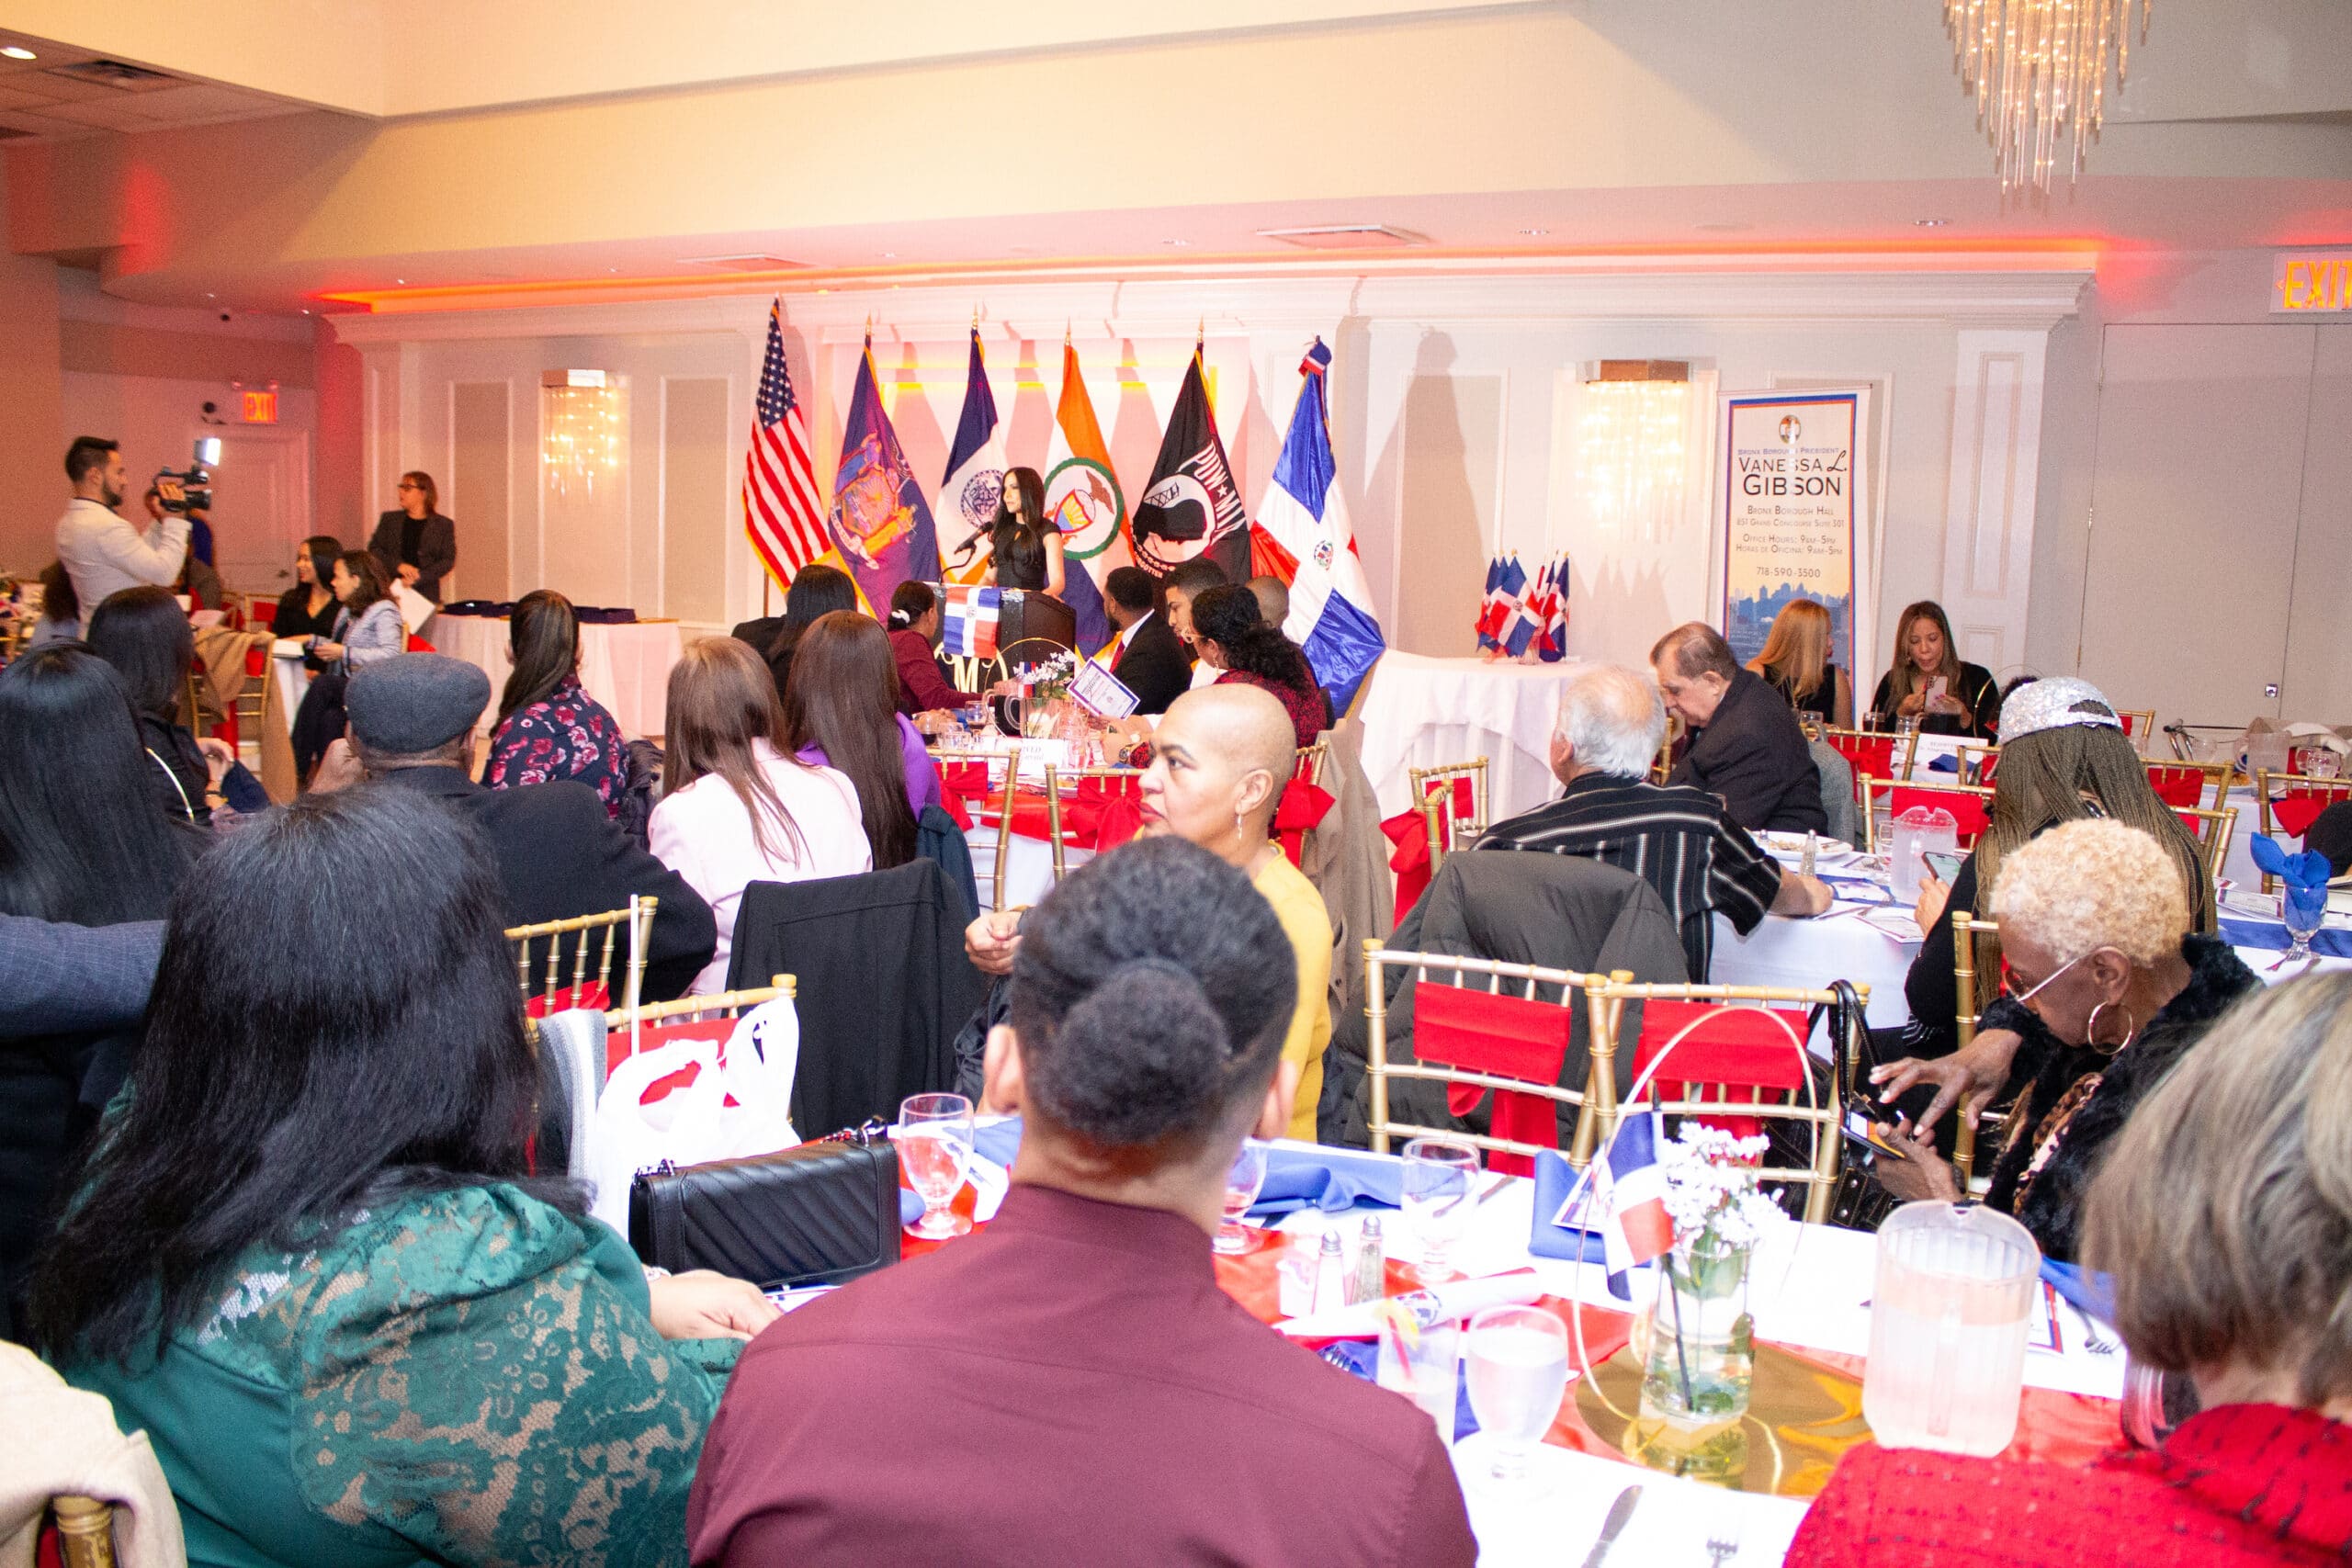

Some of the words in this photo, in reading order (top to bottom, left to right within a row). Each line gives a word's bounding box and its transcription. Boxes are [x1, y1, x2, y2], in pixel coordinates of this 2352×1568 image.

[2283, 260, 2352, 309] EXIT
[244, 392, 277, 422] EXIT
[1177, 439, 1228, 491] POW
[1743, 474, 1840, 496] GIBSON
